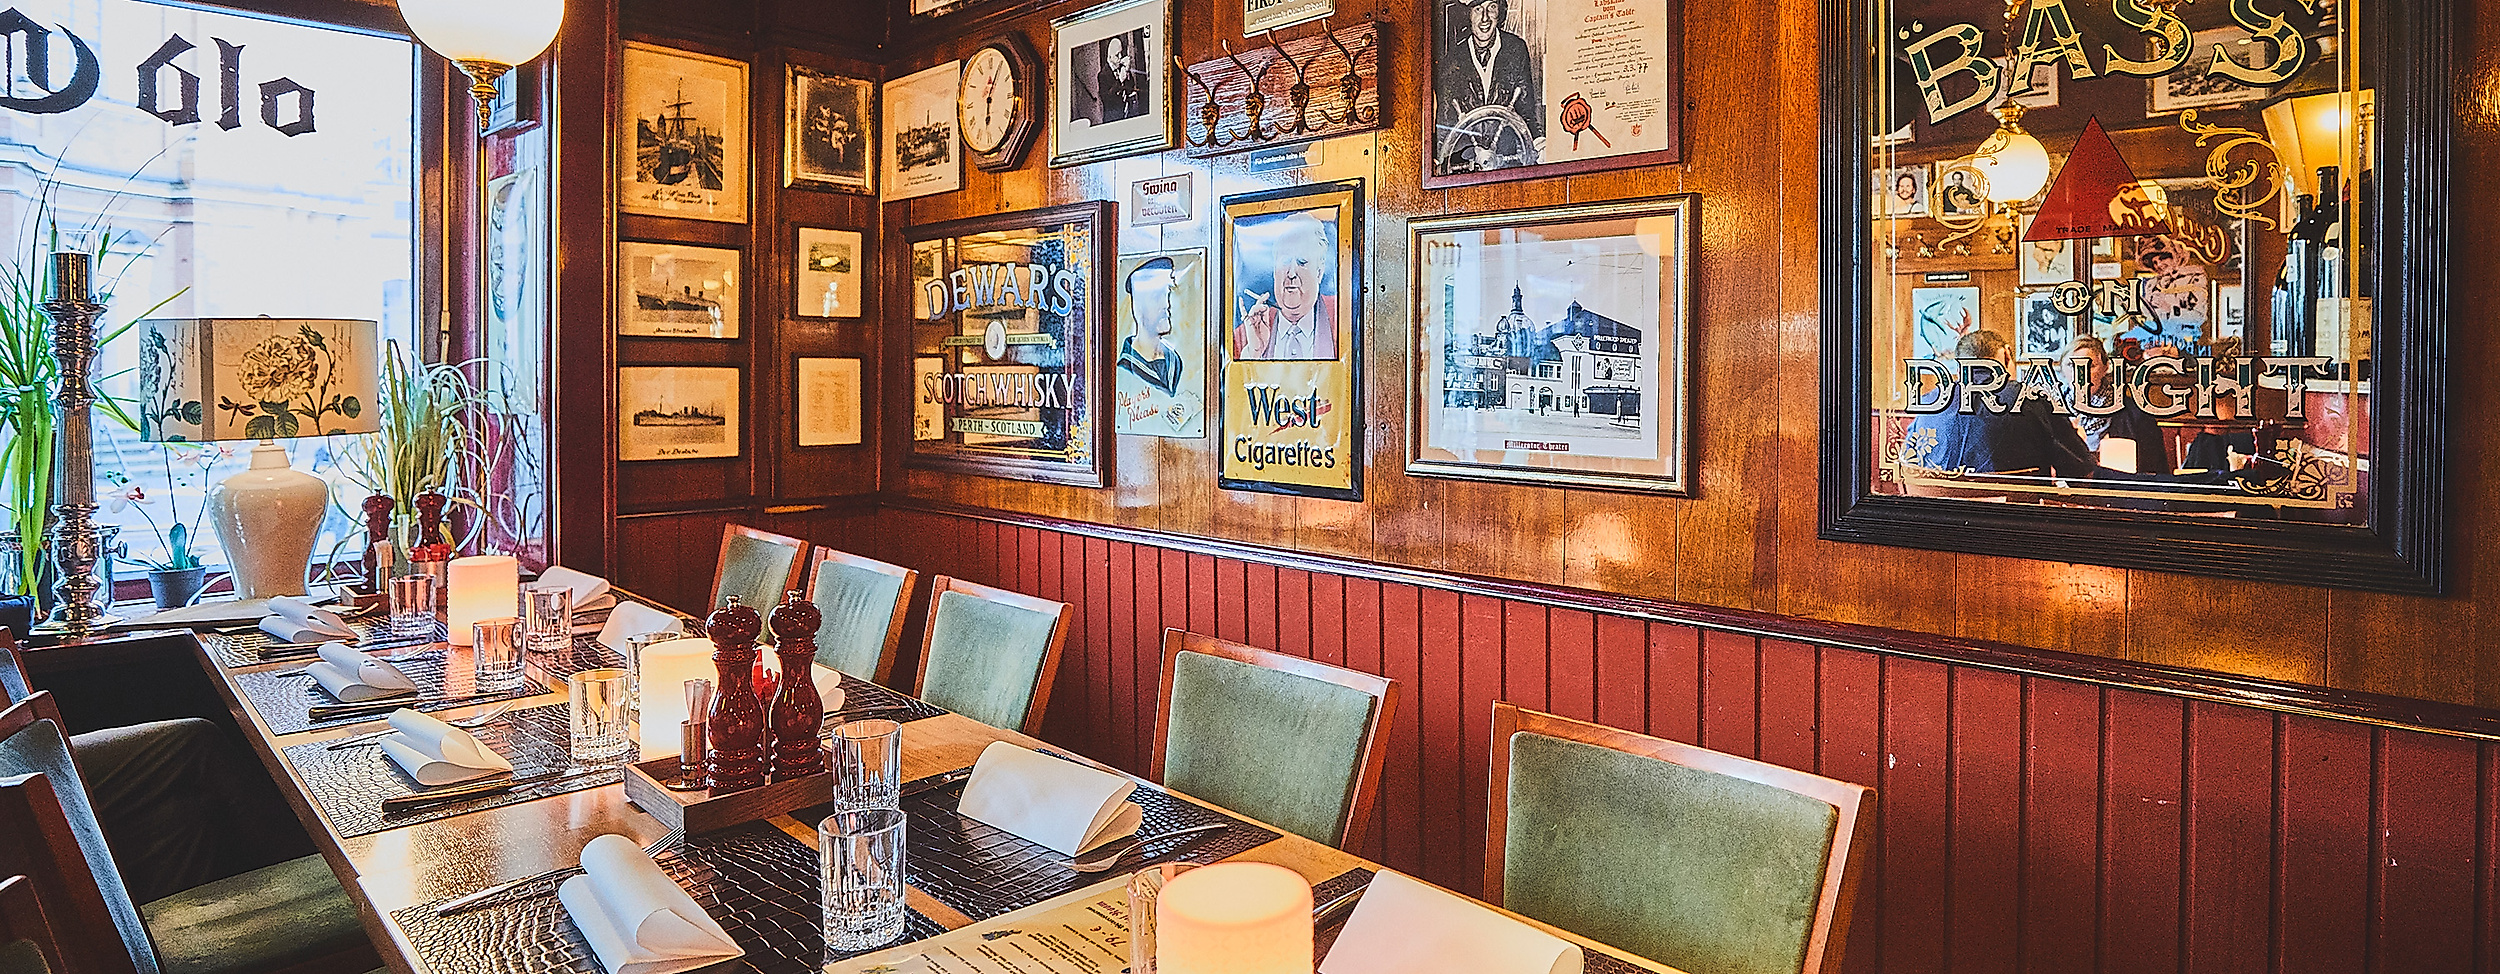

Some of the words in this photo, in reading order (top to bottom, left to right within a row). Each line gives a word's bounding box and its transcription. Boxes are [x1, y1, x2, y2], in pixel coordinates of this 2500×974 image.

[2056, 225, 2091, 234] TRADE
[2103, 223, 2135, 232] MAR
[923, 261, 1075, 322] DEWAR'S
[2049, 276, 2142, 317] ON
[923, 374, 987, 406] SCOTCH
[990, 373, 1076, 409] WHISKY
[1245, 382, 1321, 430] West
[1903, 355, 2334, 420] DRAUGHT
[958, 418, 984, 431] PERTH
[1234, 434, 1335, 471] Cigarettes
